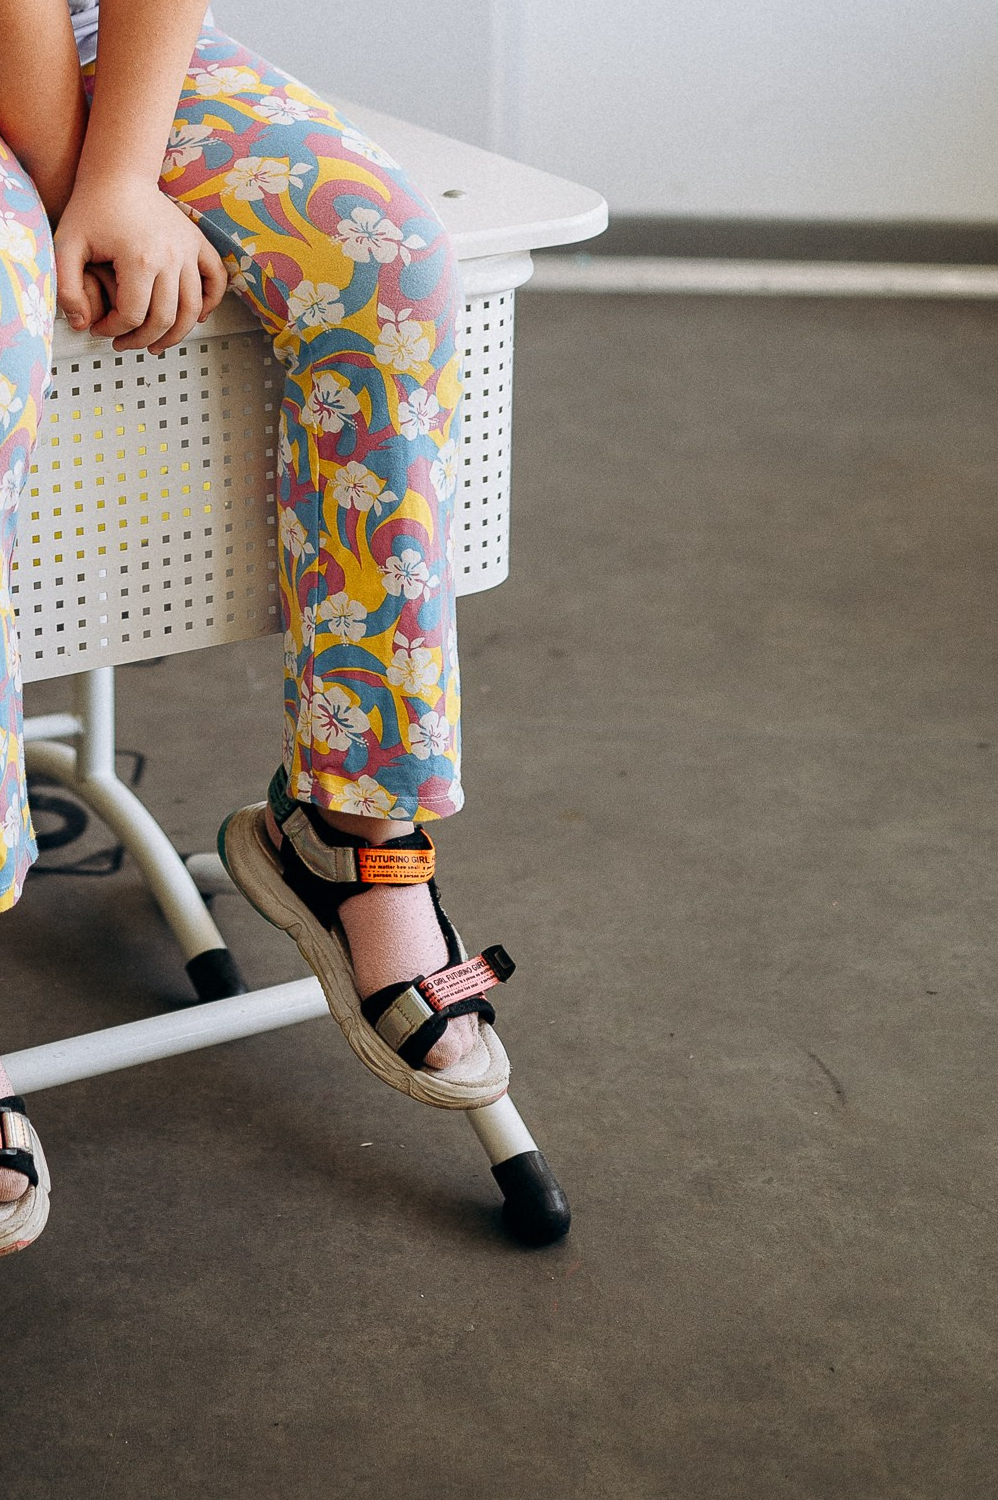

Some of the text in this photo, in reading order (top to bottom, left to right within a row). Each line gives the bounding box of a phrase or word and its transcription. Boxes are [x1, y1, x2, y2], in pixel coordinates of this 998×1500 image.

[364, 854, 410, 864] FUTURINO
[410, 855, 431, 864] GIRL
[471, 960, 488, 972] GIRL
